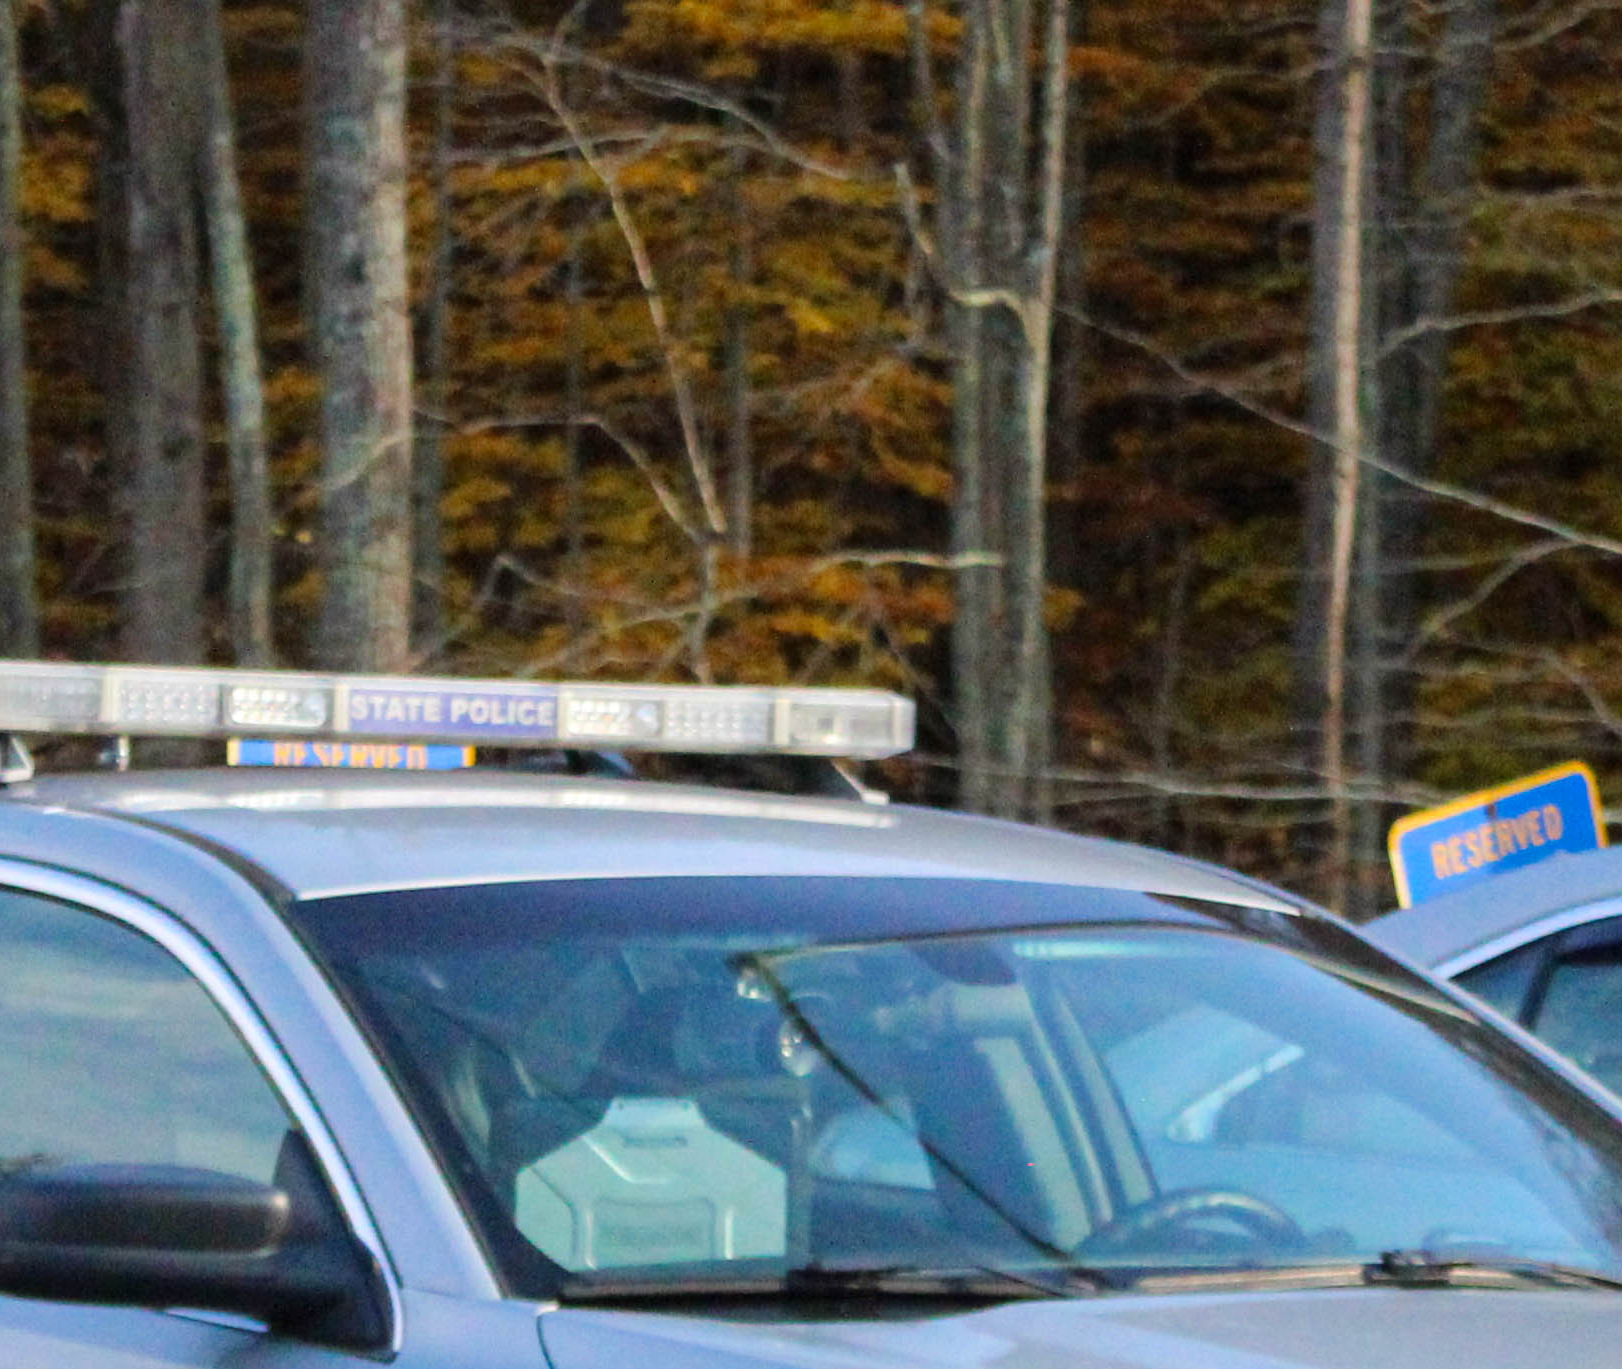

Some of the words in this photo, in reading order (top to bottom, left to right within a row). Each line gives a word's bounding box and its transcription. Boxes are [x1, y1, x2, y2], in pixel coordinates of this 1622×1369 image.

[351, 695, 442, 723] STATE
[450, 698, 555, 728] POLICE
[1431, 803, 1564, 881] RESERVED
